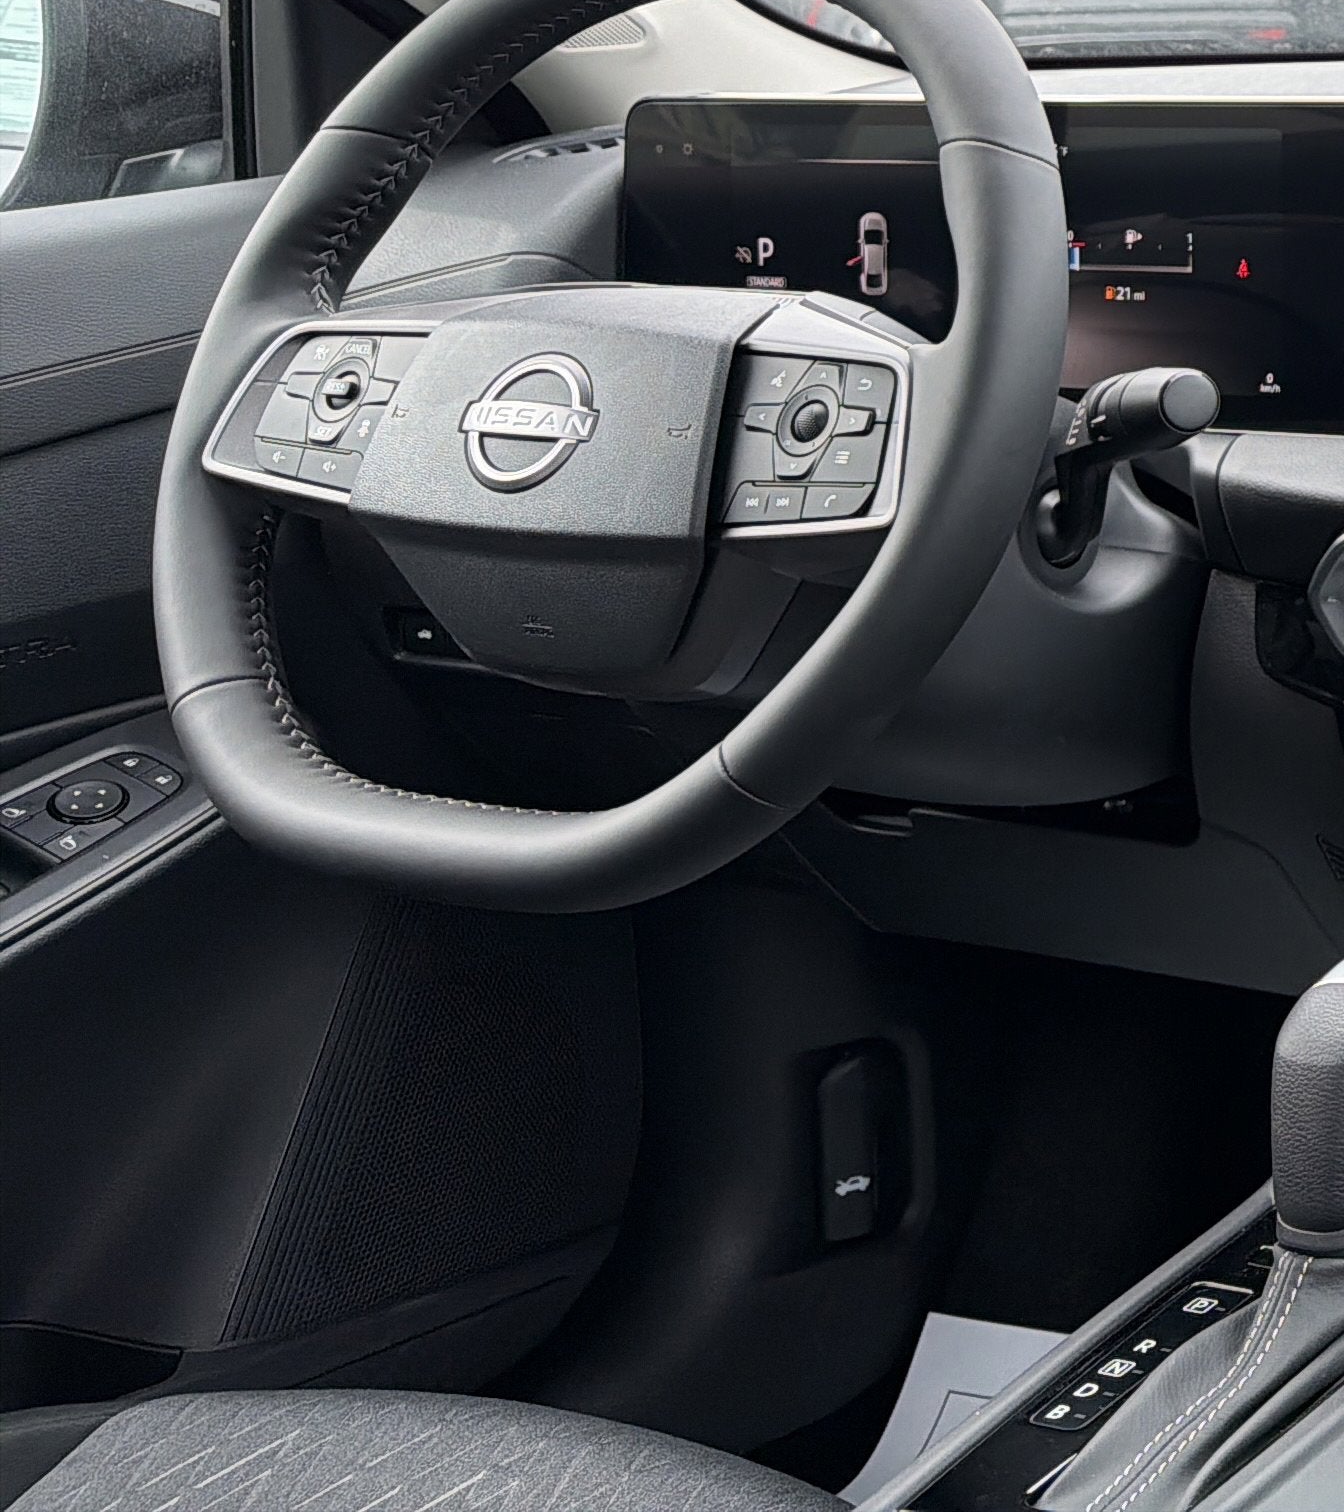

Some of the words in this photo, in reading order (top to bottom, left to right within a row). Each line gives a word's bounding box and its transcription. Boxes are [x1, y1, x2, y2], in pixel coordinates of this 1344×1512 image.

[756, 237, 774, 266] P
[749, 277, 786, 287] STANDARD
[1116, 286, 1130, 300] 21
[1134, 291, 1145, 301] mi
[345, 343, 371, 355] CANCEL
[1260, 383, 1281, 393] km/h
[469, 406, 593, 437] NISSAN
[1134, 1339, 1157, 1353] R
[1073, 1383, 1098, 1397] D
[1045, 1405, 1070, 1419] B
